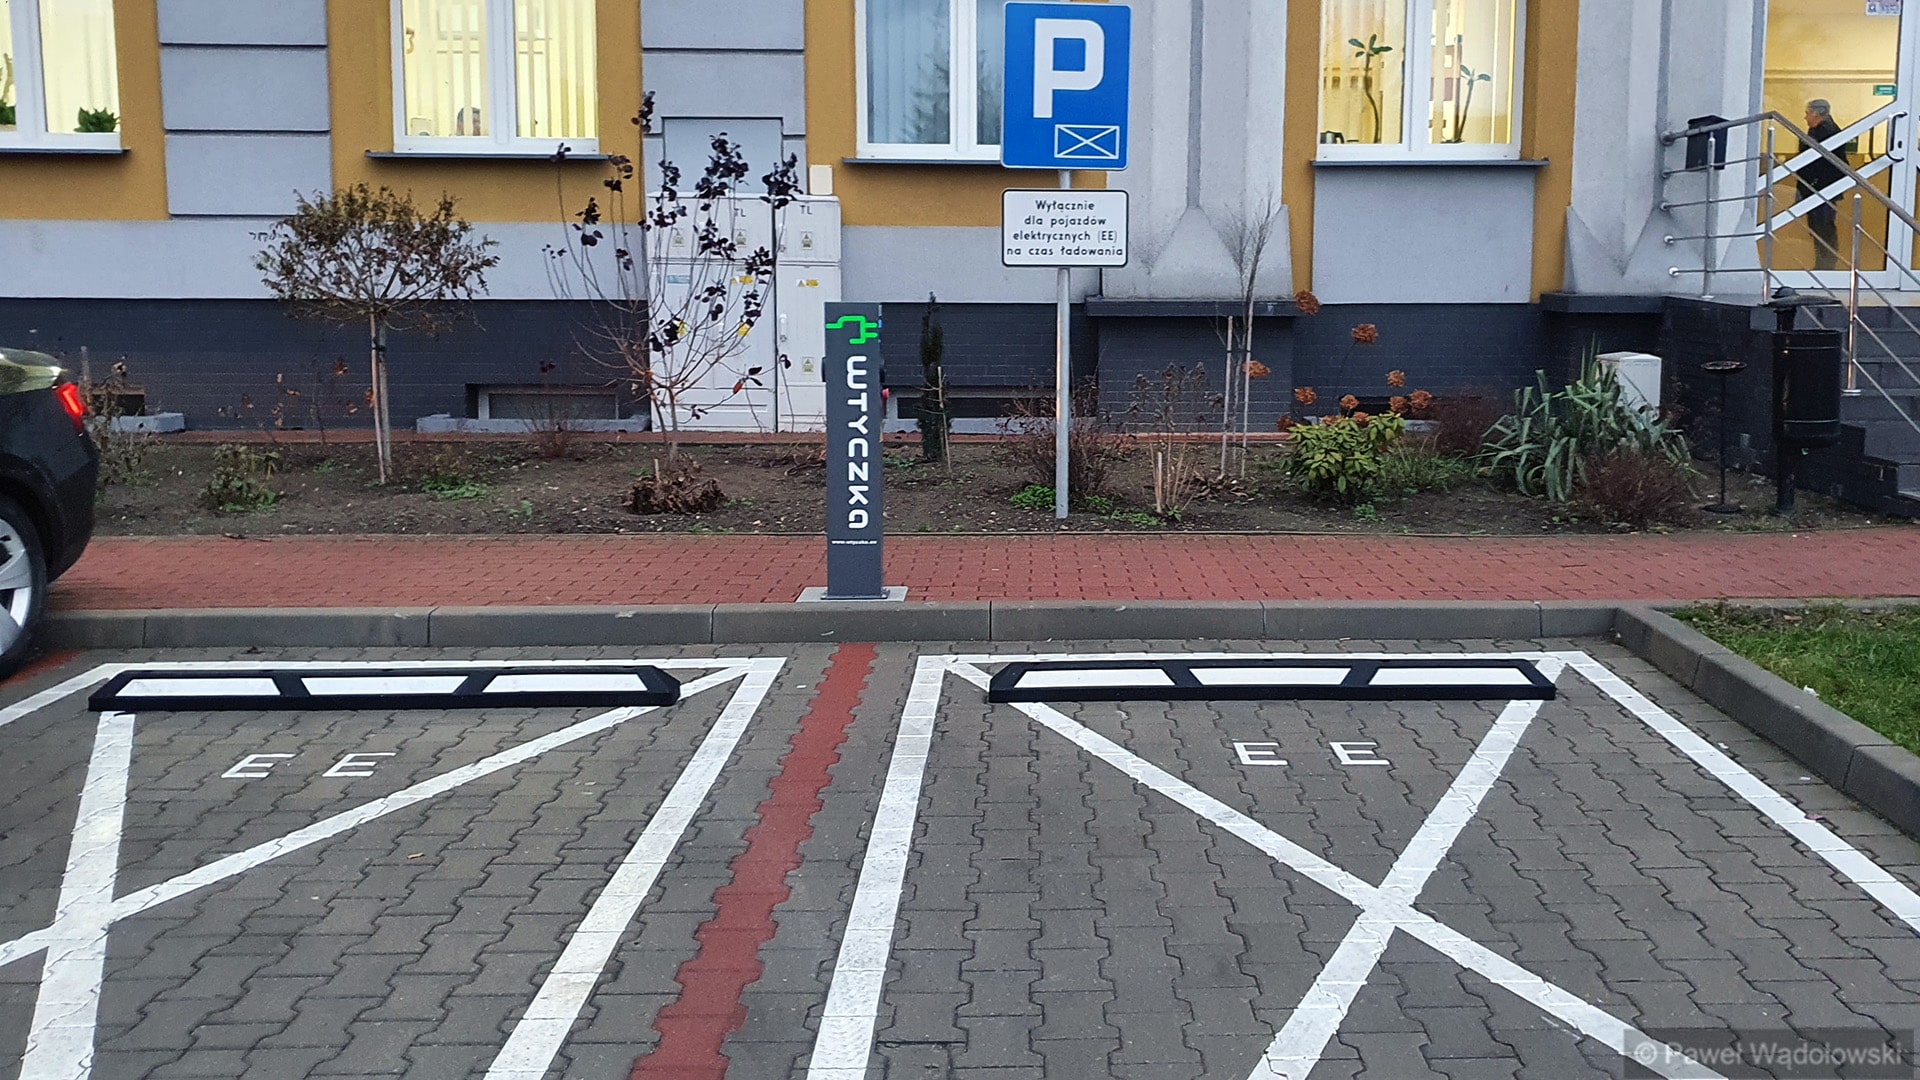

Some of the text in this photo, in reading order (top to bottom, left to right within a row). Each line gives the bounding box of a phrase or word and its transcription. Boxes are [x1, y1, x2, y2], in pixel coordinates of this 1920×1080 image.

[1033, 18, 1105, 118] P
[800, 205, 813, 215] TL
[1034, 199, 1096, 213] Wyłącznie
[1024, 215, 1107, 228] dla pojazdów
[1012, 230, 1118, 243] elektrycznych (EE)
[1060, 246, 1123, 256] ładowania
[847, 355, 869, 529] WTYCZKA
